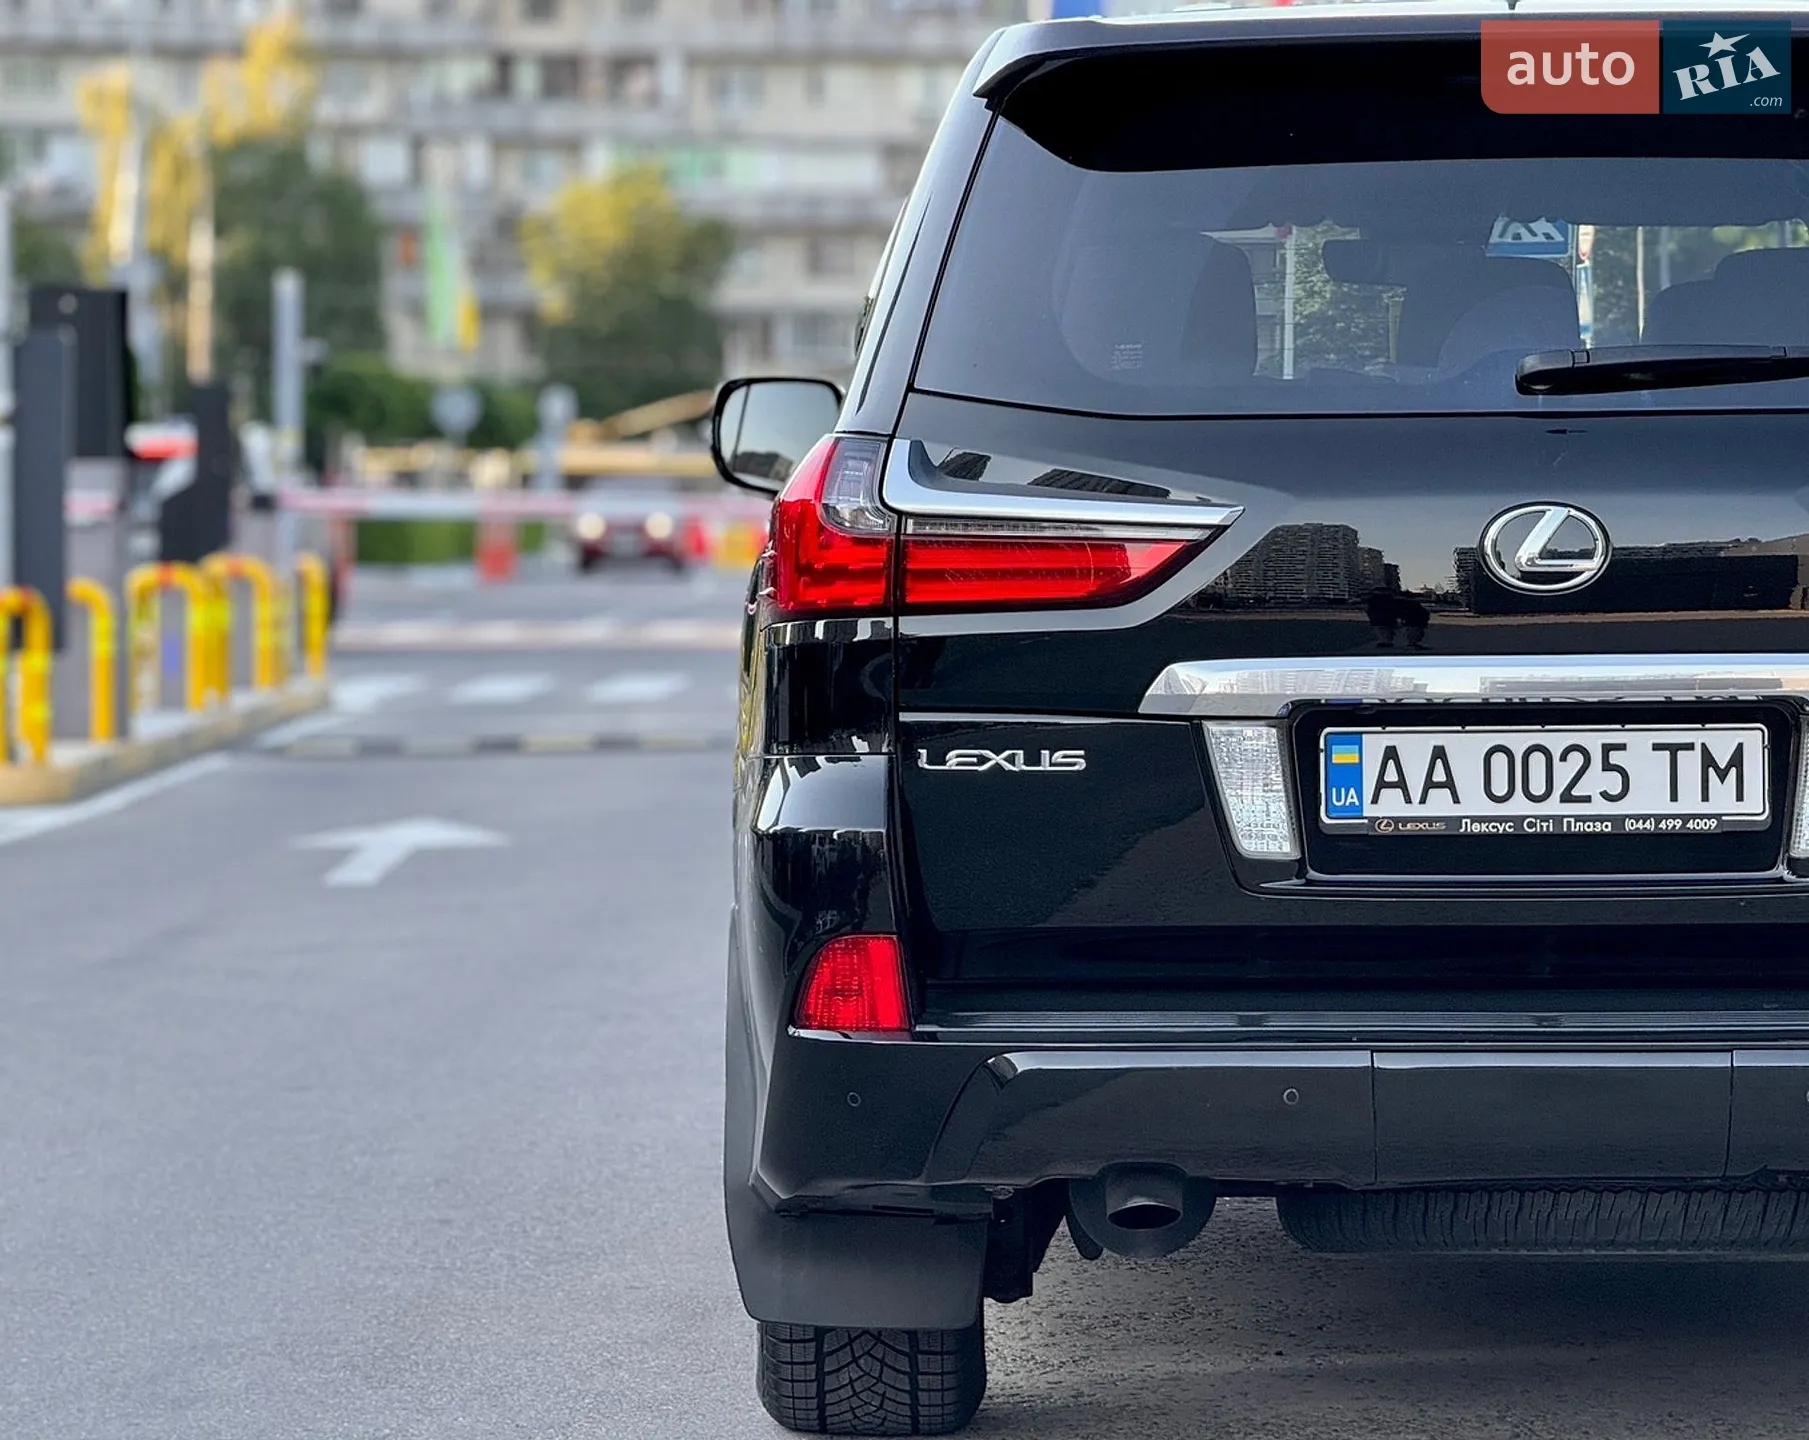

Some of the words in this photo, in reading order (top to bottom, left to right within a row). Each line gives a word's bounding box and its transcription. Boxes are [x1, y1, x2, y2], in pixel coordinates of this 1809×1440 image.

[917, 748, 1087, 772] LEXUS
[1370, 744, 1461, 805] AA
[1482, 742, 1632, 804] 0025
[1651, 741, 1745, 803] TM
[1331, 786, 1360, 807] UA
[1398, 821, 1447, 831] LEXUS
[1459, 818, 1515, 834] Лексус
[1523, 817, 1554, 833] Сіті
[1562, 817, 1612, 833] Плаза
[1624, 817, 1655, 831] (044)
[1658, 818, 1683, 831] 499
[1686, 818, 1718, 831] 4009
